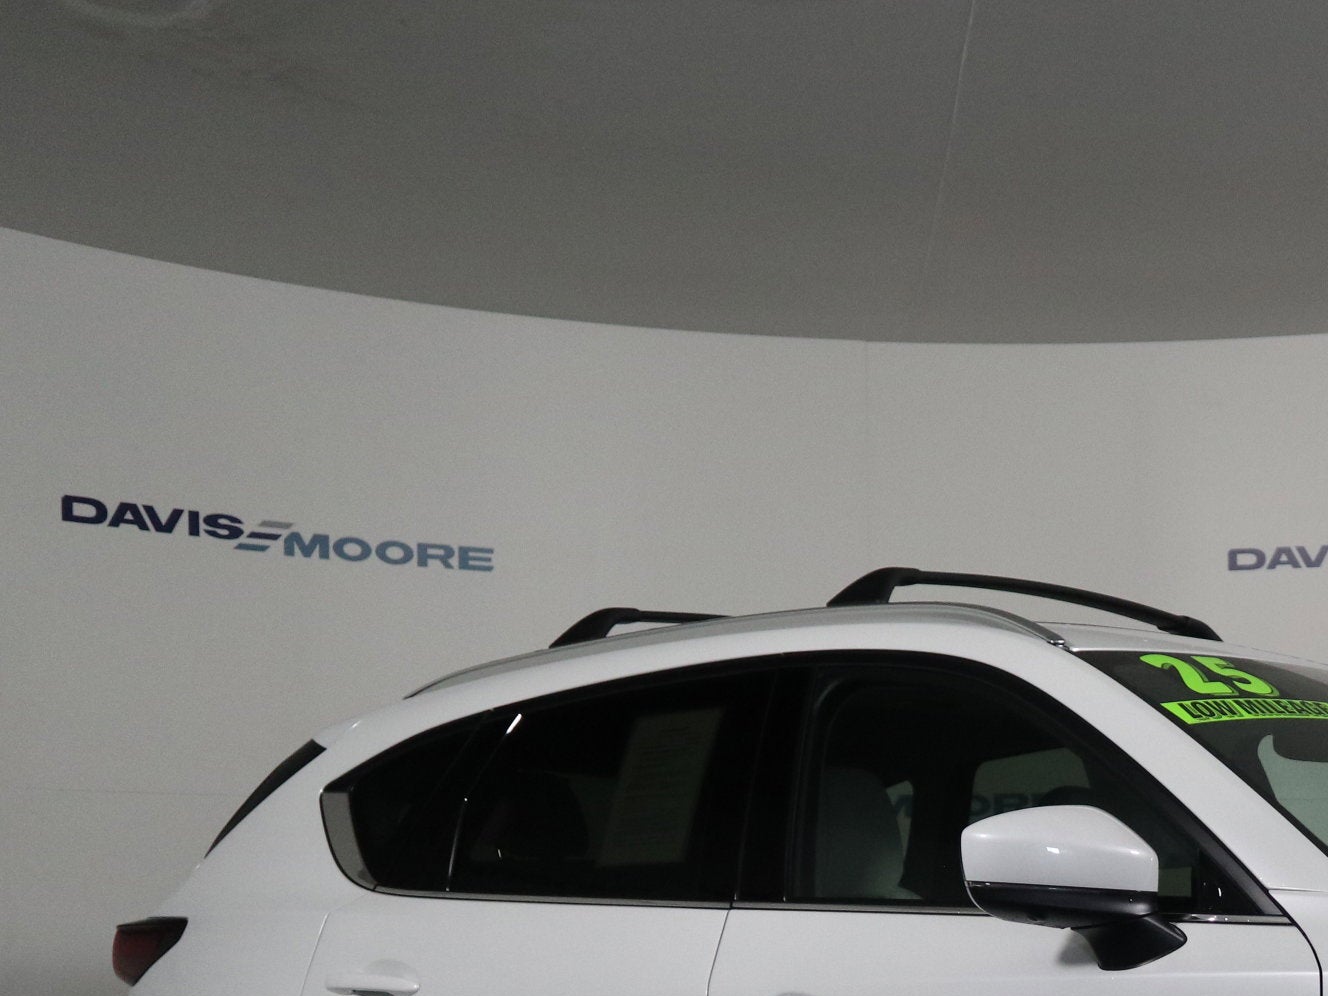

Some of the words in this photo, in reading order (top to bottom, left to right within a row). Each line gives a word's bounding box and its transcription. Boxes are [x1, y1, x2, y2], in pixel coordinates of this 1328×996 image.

[61, 494, 244, 540] DAVIS
[283, 533, 495, 572] MOORE
[1139, 653, 1280, 697] 25
[1177, 700, 1242, 722] LOW
